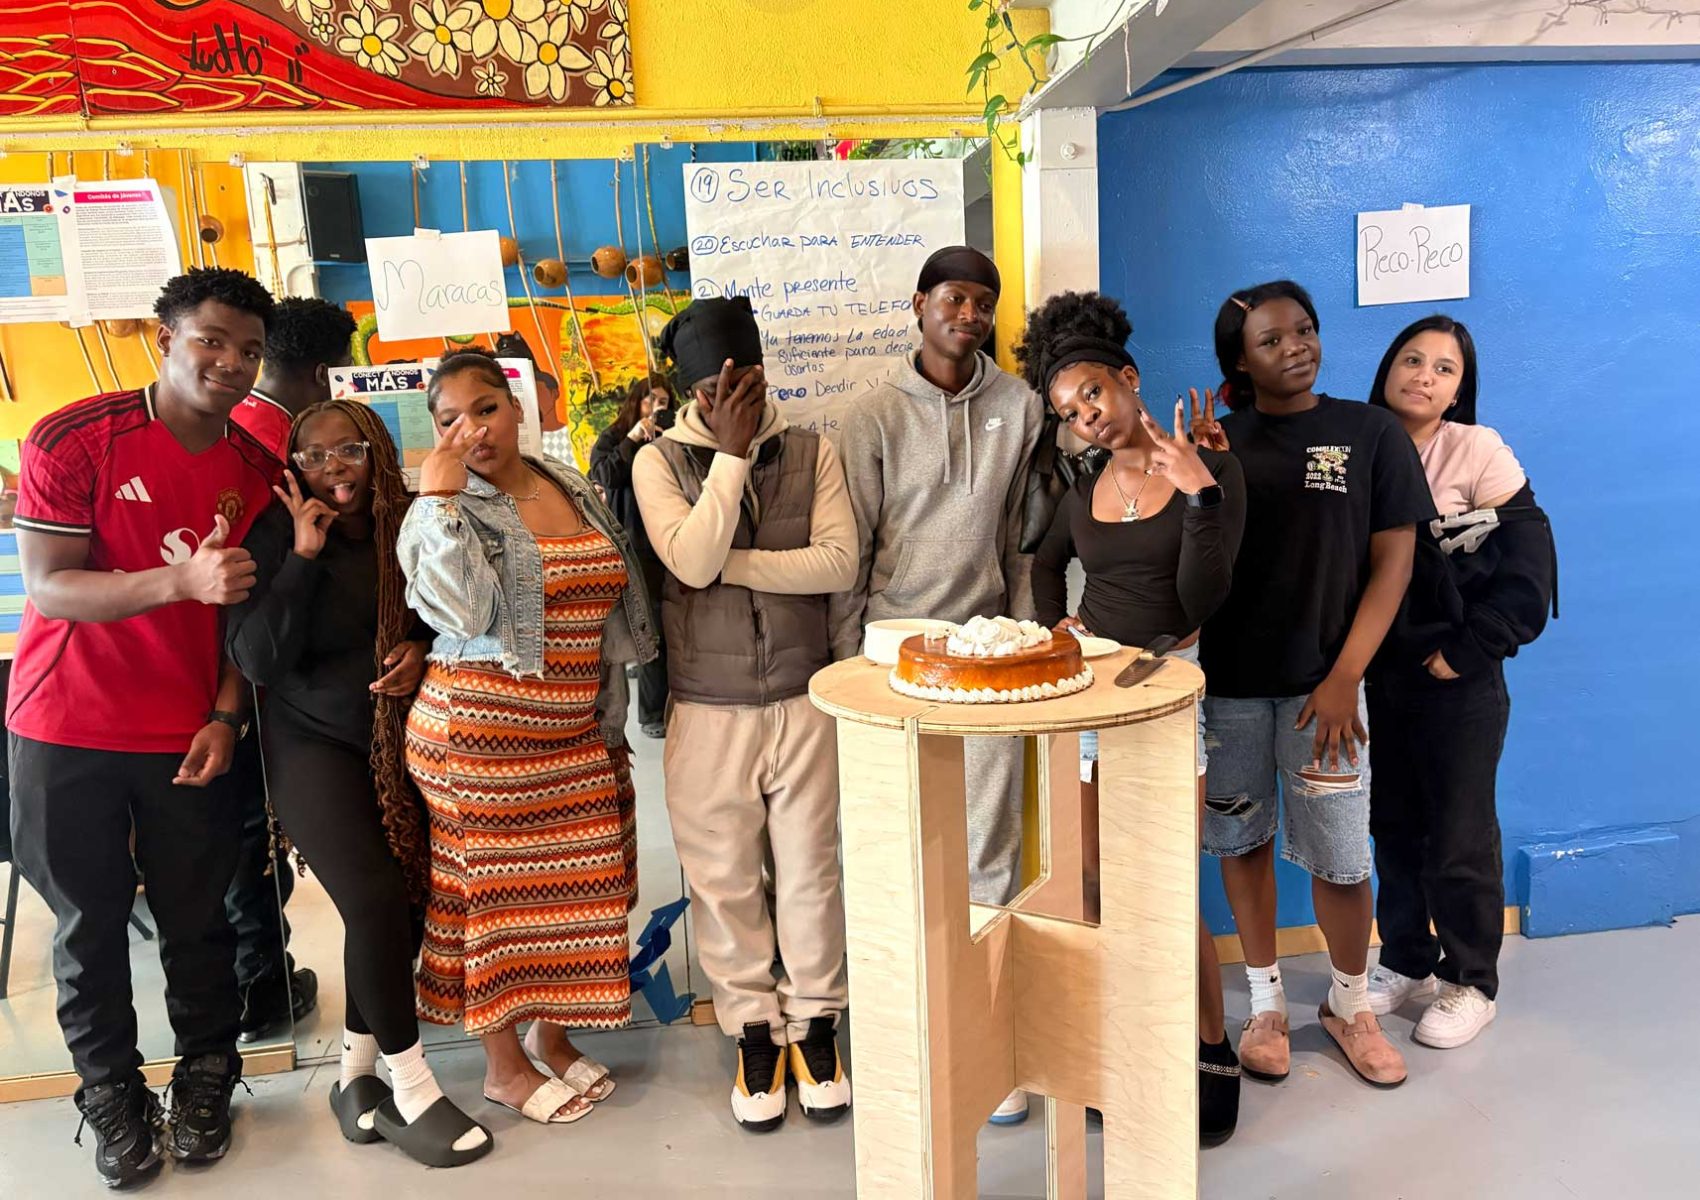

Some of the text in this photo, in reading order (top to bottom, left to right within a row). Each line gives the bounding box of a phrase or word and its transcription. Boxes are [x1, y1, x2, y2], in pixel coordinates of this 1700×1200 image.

[808, 169, 939, 200] Inclusivos
[0, 187, 35, 213] ÁS
[851, 233, 926, 249] ENTENDER
[377, 259, 503, 315] Maracas
[761, 304, 812, 322] GUARDA
[817, 304, 838, 317] TU
[872, 323, 910, 340] edad
[815, 378, 857, 397] Decidir
[1304, 480, 1348, 494] Long Beach
